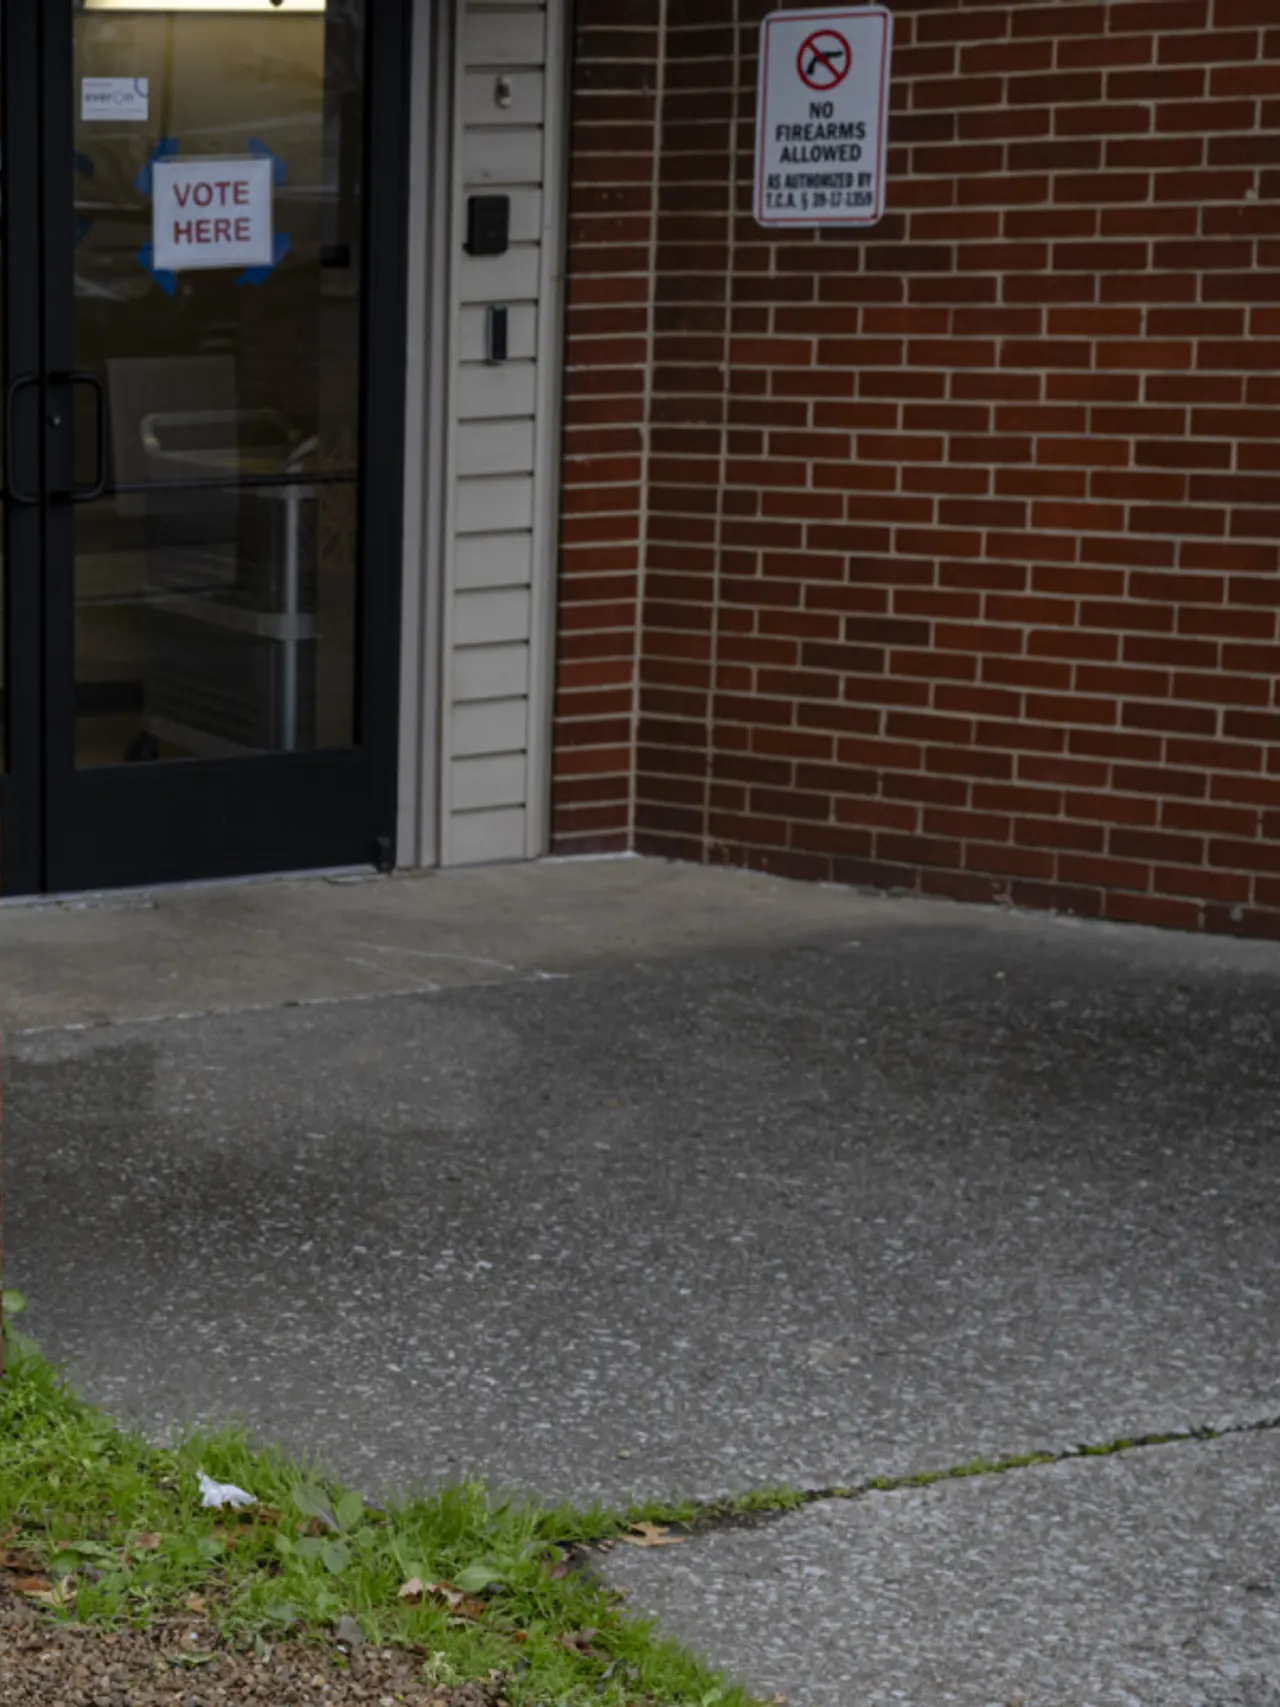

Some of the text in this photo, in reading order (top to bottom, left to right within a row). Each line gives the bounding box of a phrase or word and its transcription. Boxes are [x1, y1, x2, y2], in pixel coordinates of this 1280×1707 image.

[809, 101, 834, 120] NO
[775, 121, 866, 142] FIREARMS
[779, 143, 862, 164] ALLOWED
[767, 171, 872, 190] AS AUTHORIZED BY
[173, 181, 250, 208] VOTE
[173, 217, 252, 245] HERE
